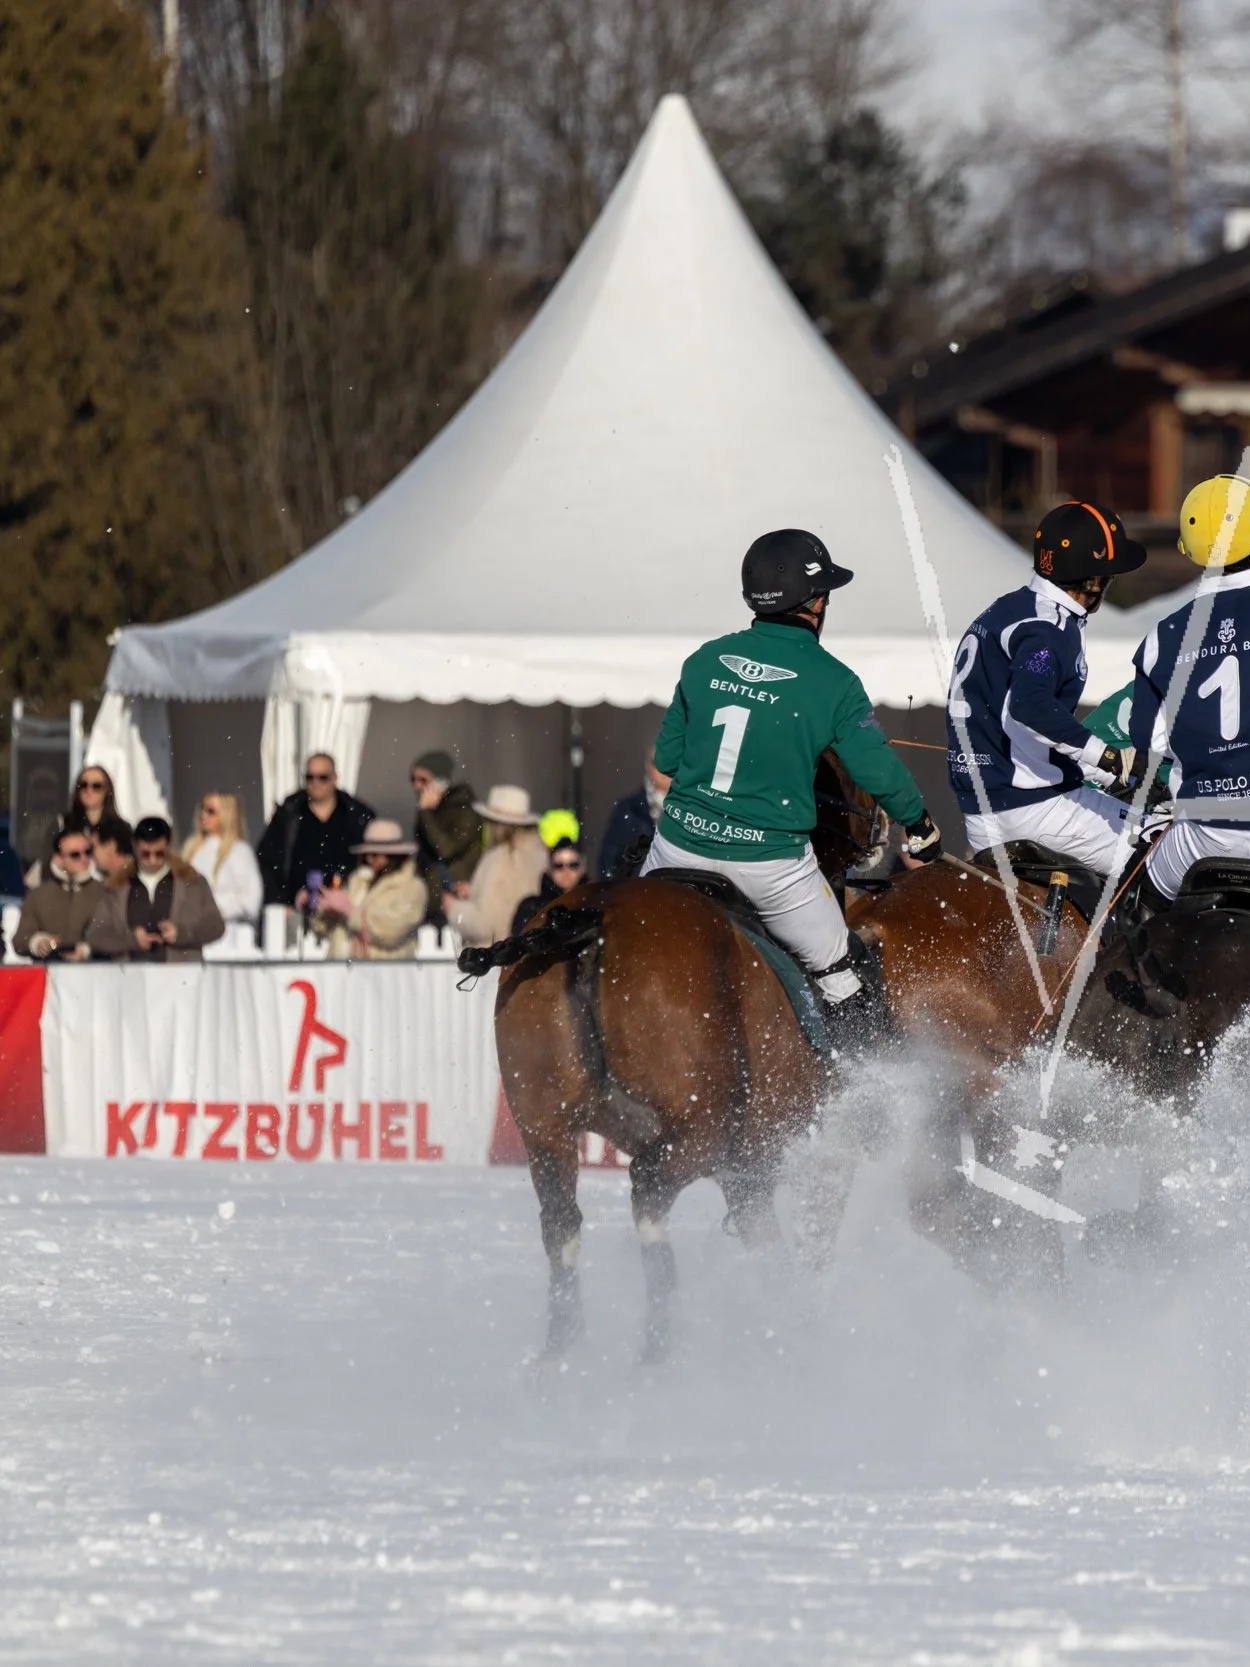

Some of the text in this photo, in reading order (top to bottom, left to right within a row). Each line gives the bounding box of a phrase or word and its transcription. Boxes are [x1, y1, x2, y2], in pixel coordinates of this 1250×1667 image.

[1176, 643, 1238, 665] BENDURA
[949, 634, 979, 718] 2
[709, 678, 780, 705] BENTLEY
[1198, 655, 1240, 740] 1
[711, 704, 751, 793] 1
[1209, 742, 1249, 754] Limited Edition
[1196, 780, 1215, 794] U.S.
[1215, 776, 1248, 793] POLO
[1217, 791, 1241, 802] SINCE
[683, 812, 720, 833] POLO
[722, 825, 766, 843] ASSN.
